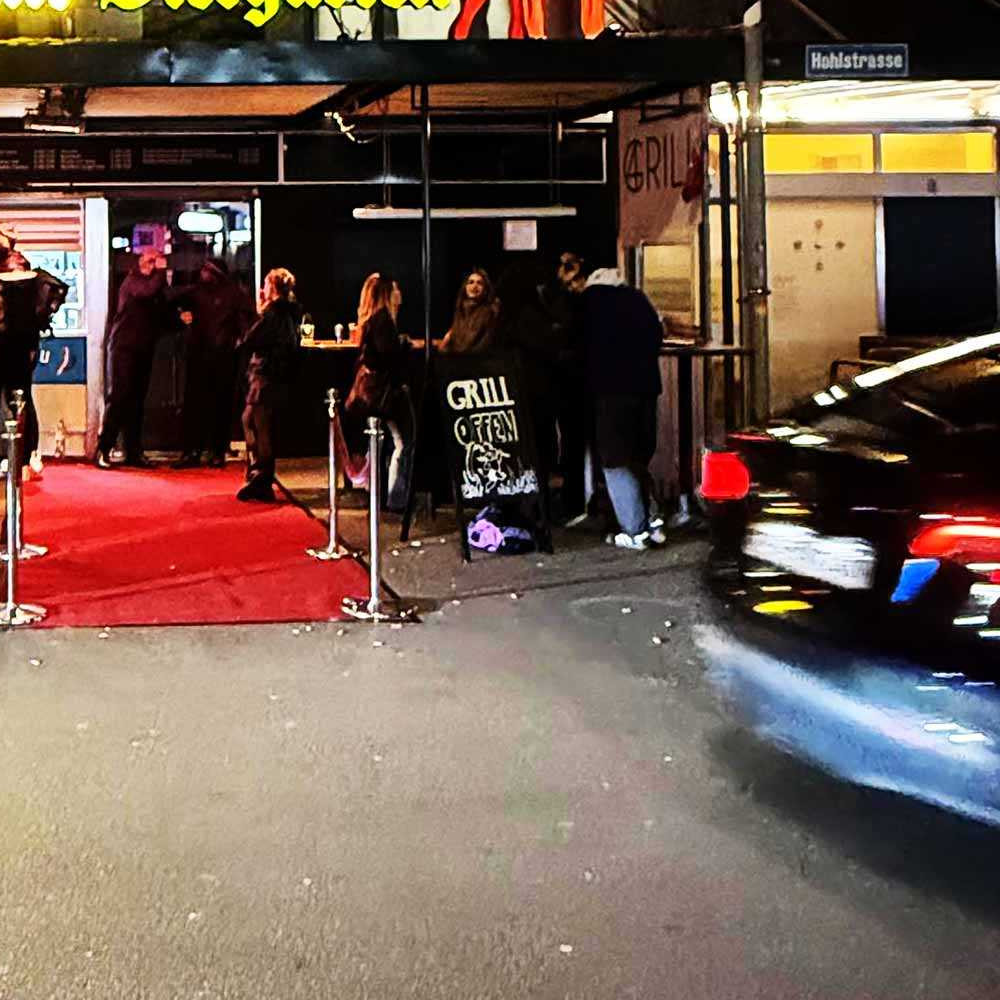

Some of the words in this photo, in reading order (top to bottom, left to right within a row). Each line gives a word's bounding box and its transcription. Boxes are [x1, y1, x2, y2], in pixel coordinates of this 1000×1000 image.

[811, 51, 903, 70] Hohlstrasse
[446, 375, 515, 410] GRILL
[454, 409, 519, 446] OFFEN
